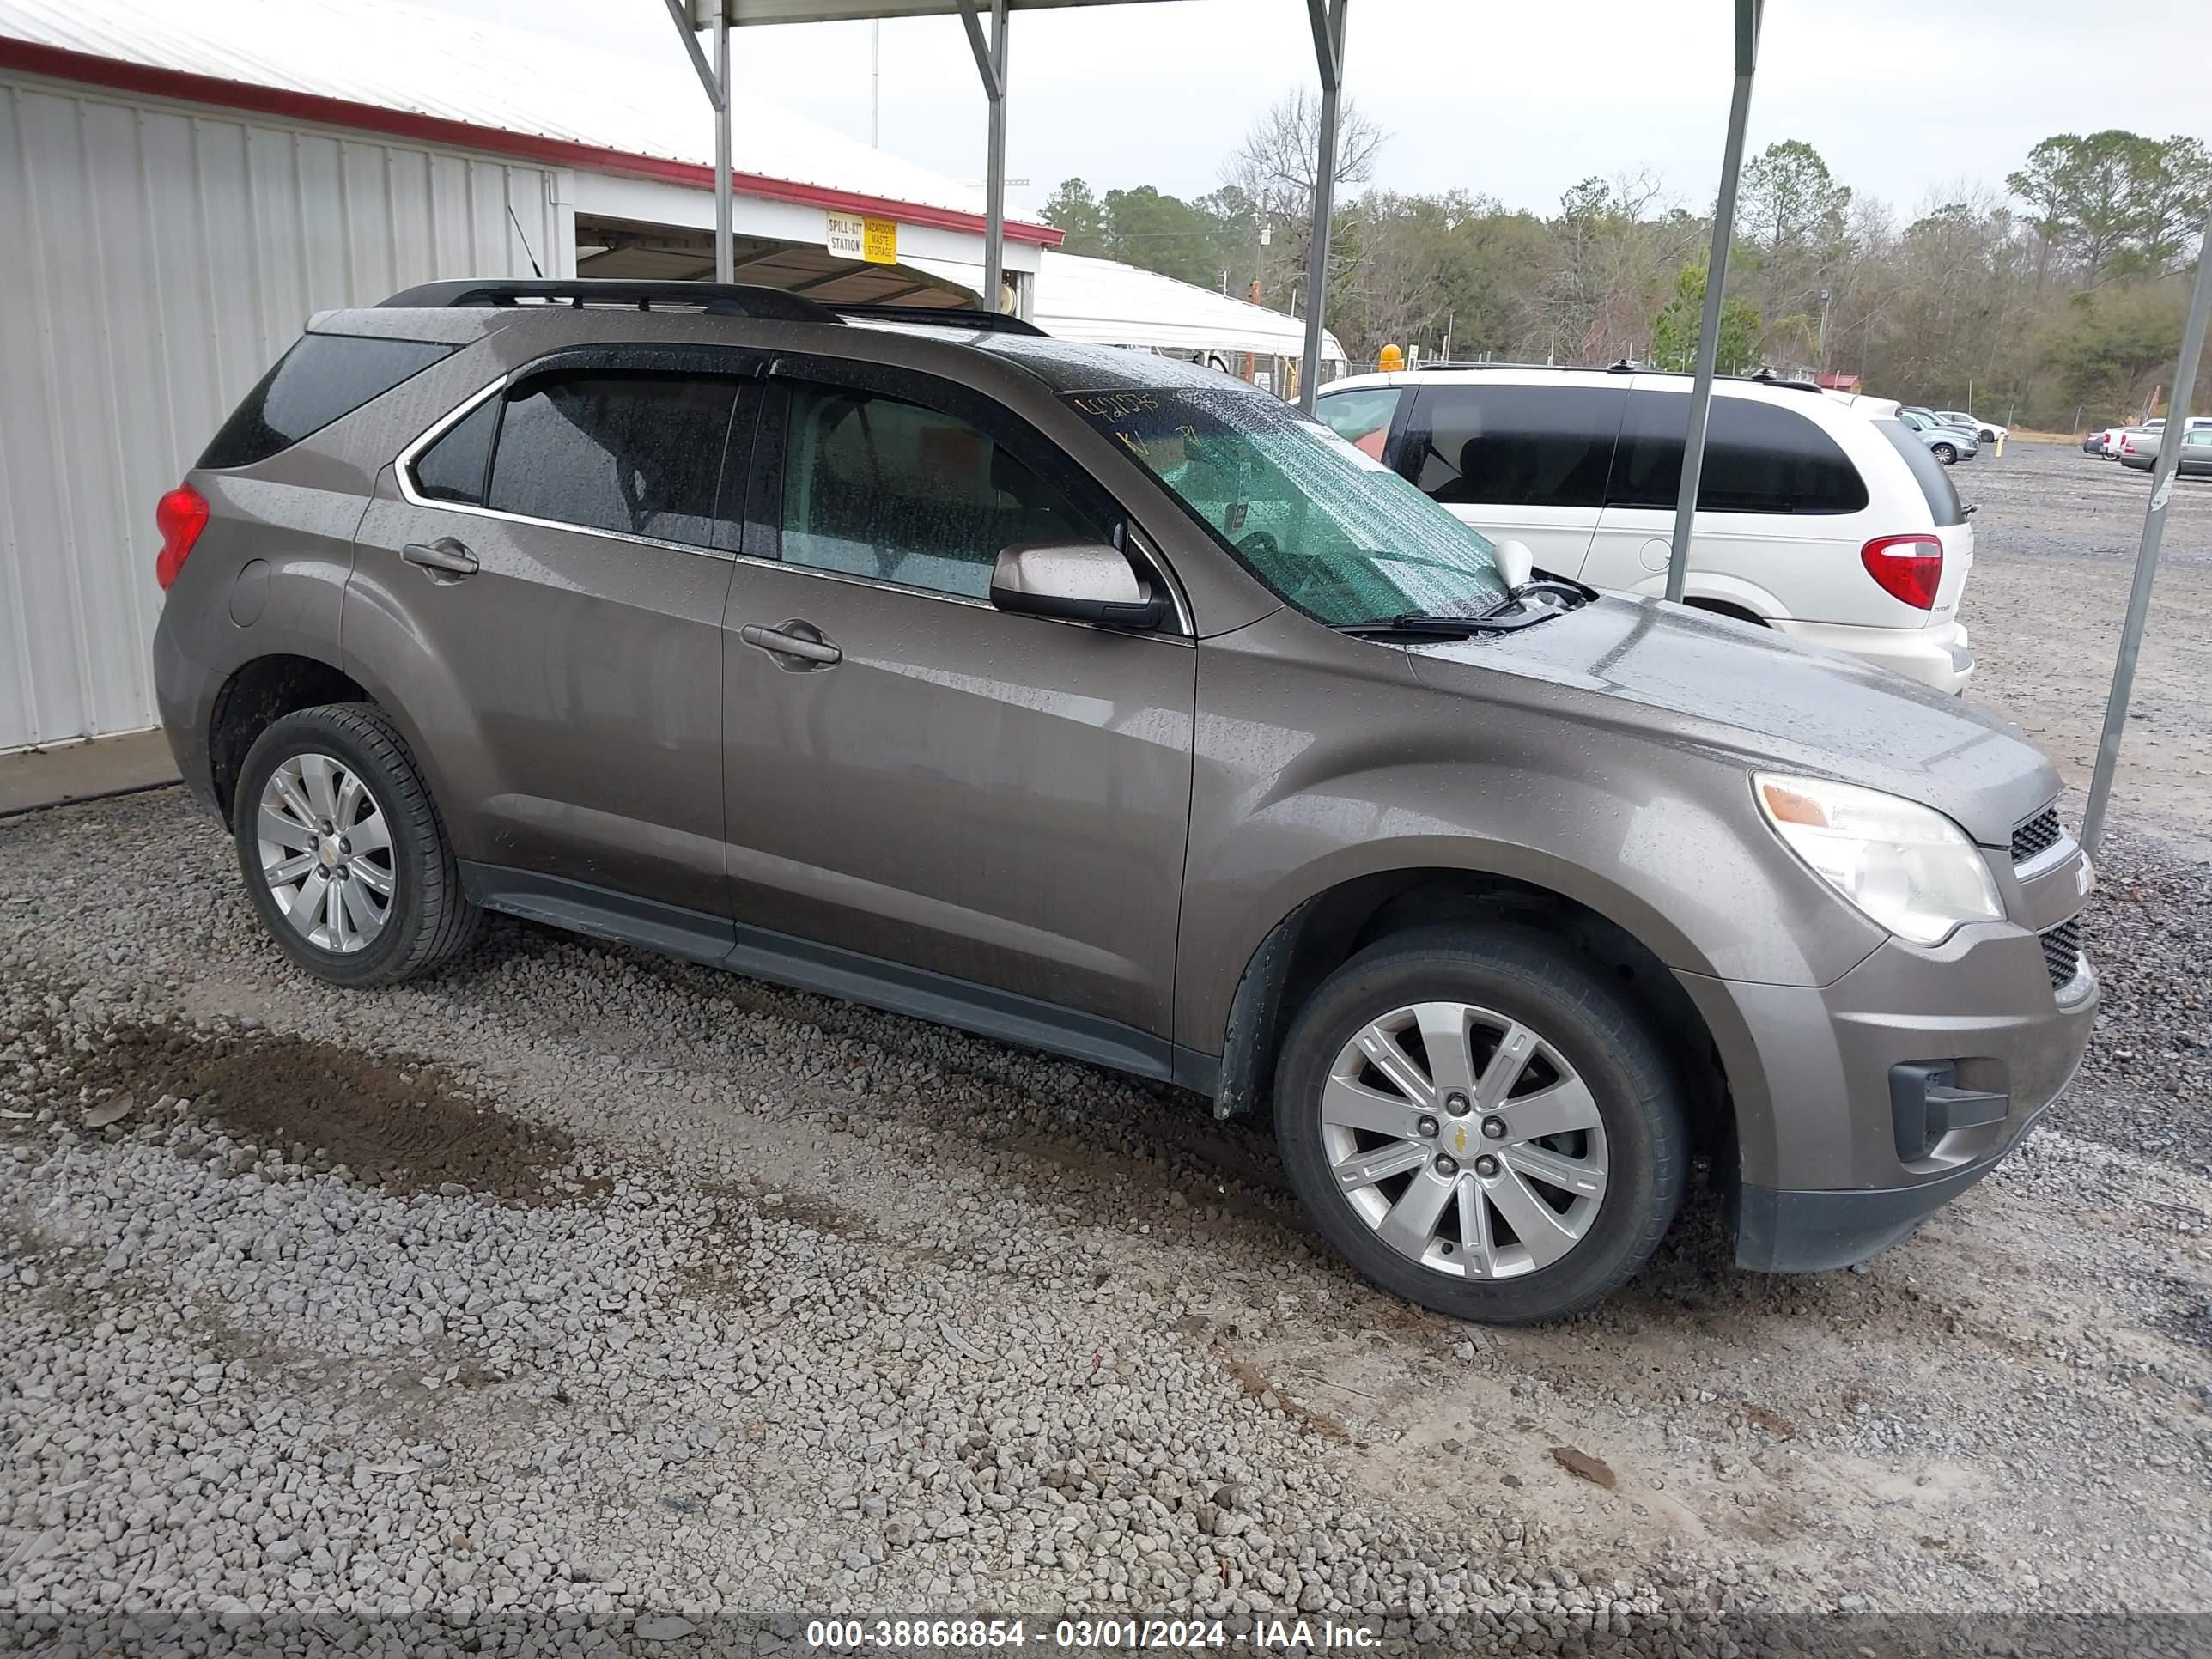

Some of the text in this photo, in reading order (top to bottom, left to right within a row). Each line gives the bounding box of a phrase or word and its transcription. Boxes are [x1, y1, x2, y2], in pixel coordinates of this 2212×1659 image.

[829, 219, 862, 235] SPILL-KIT
[831, 237, 860, 252] STATION
[872, 234, 889, 246] WASTE
